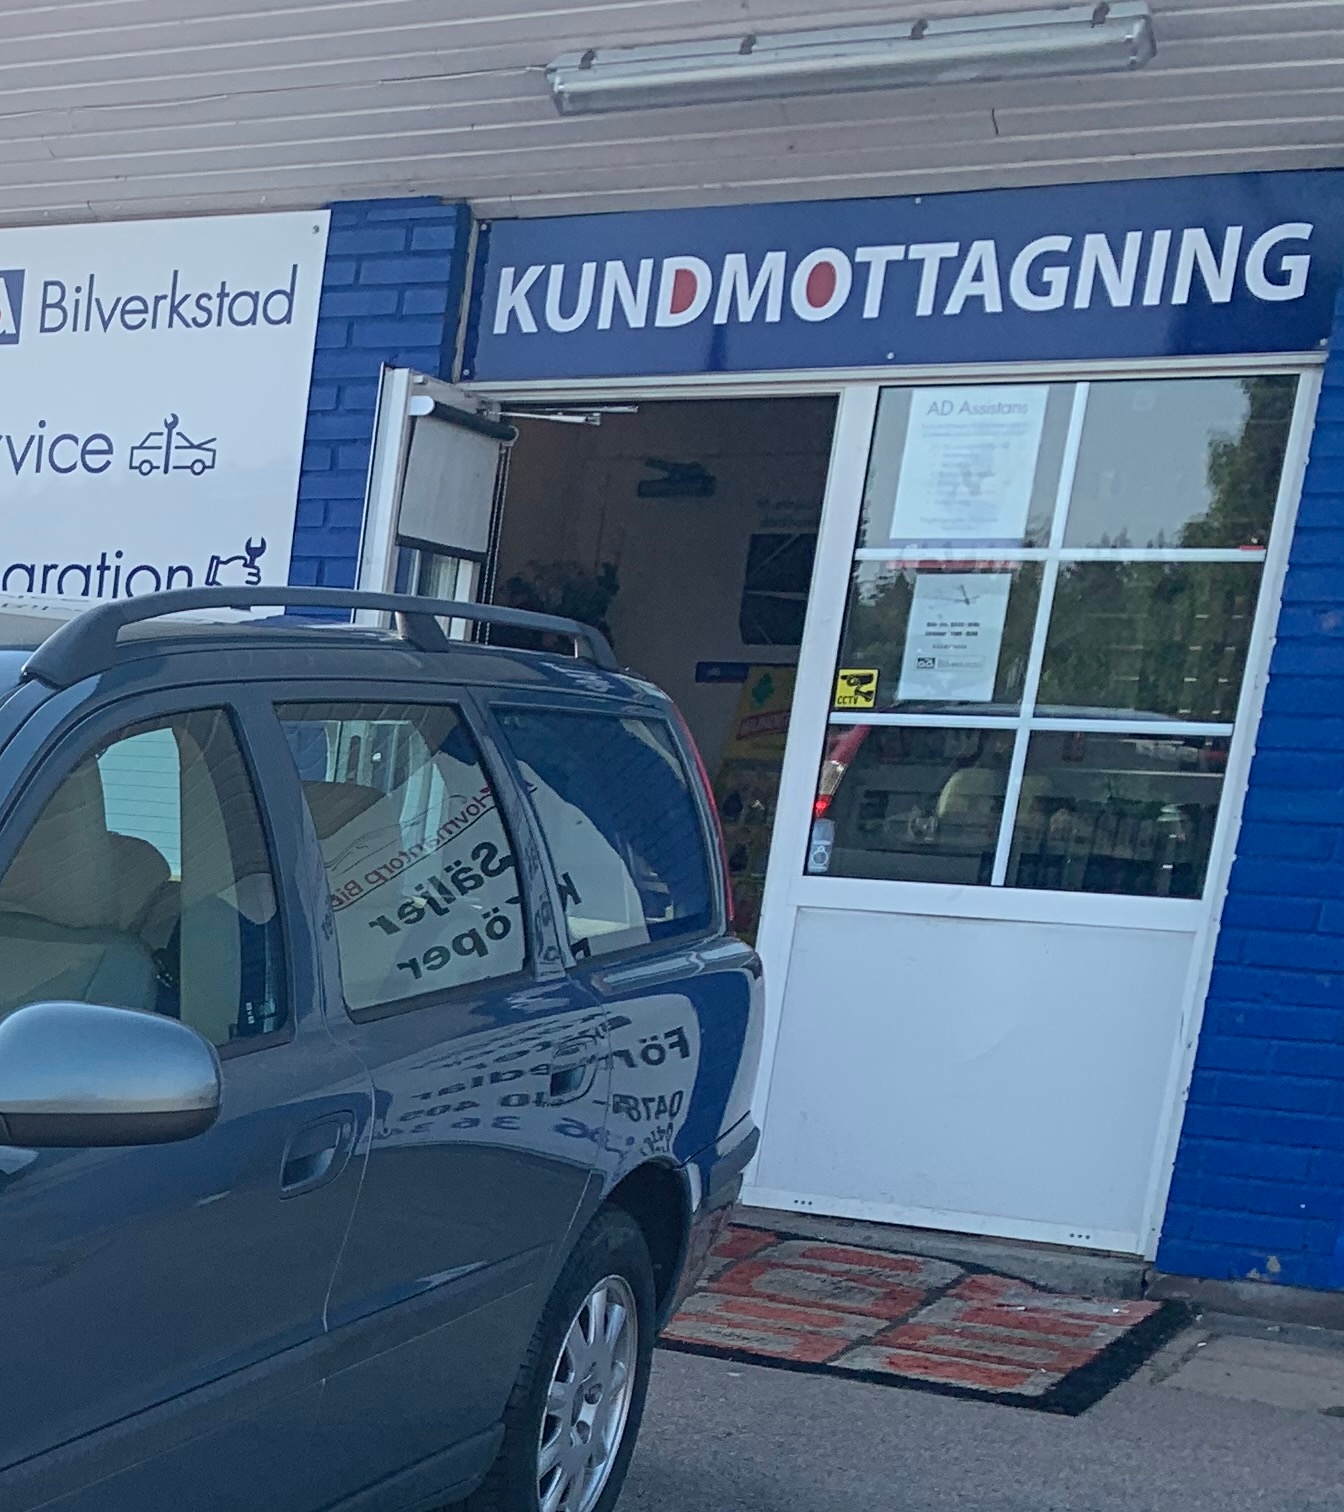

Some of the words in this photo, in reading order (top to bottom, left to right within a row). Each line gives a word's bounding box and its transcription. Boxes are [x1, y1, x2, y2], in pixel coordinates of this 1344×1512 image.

[39, 263, 298, 334] Bilverkstad
[492, 222, 1313, 335] KUNDMOTTAGNING
[926, 400, 955, 417] AD
[958, 400, 1029, 416] Assistans
[836, 695, 859, 705] CCTV
